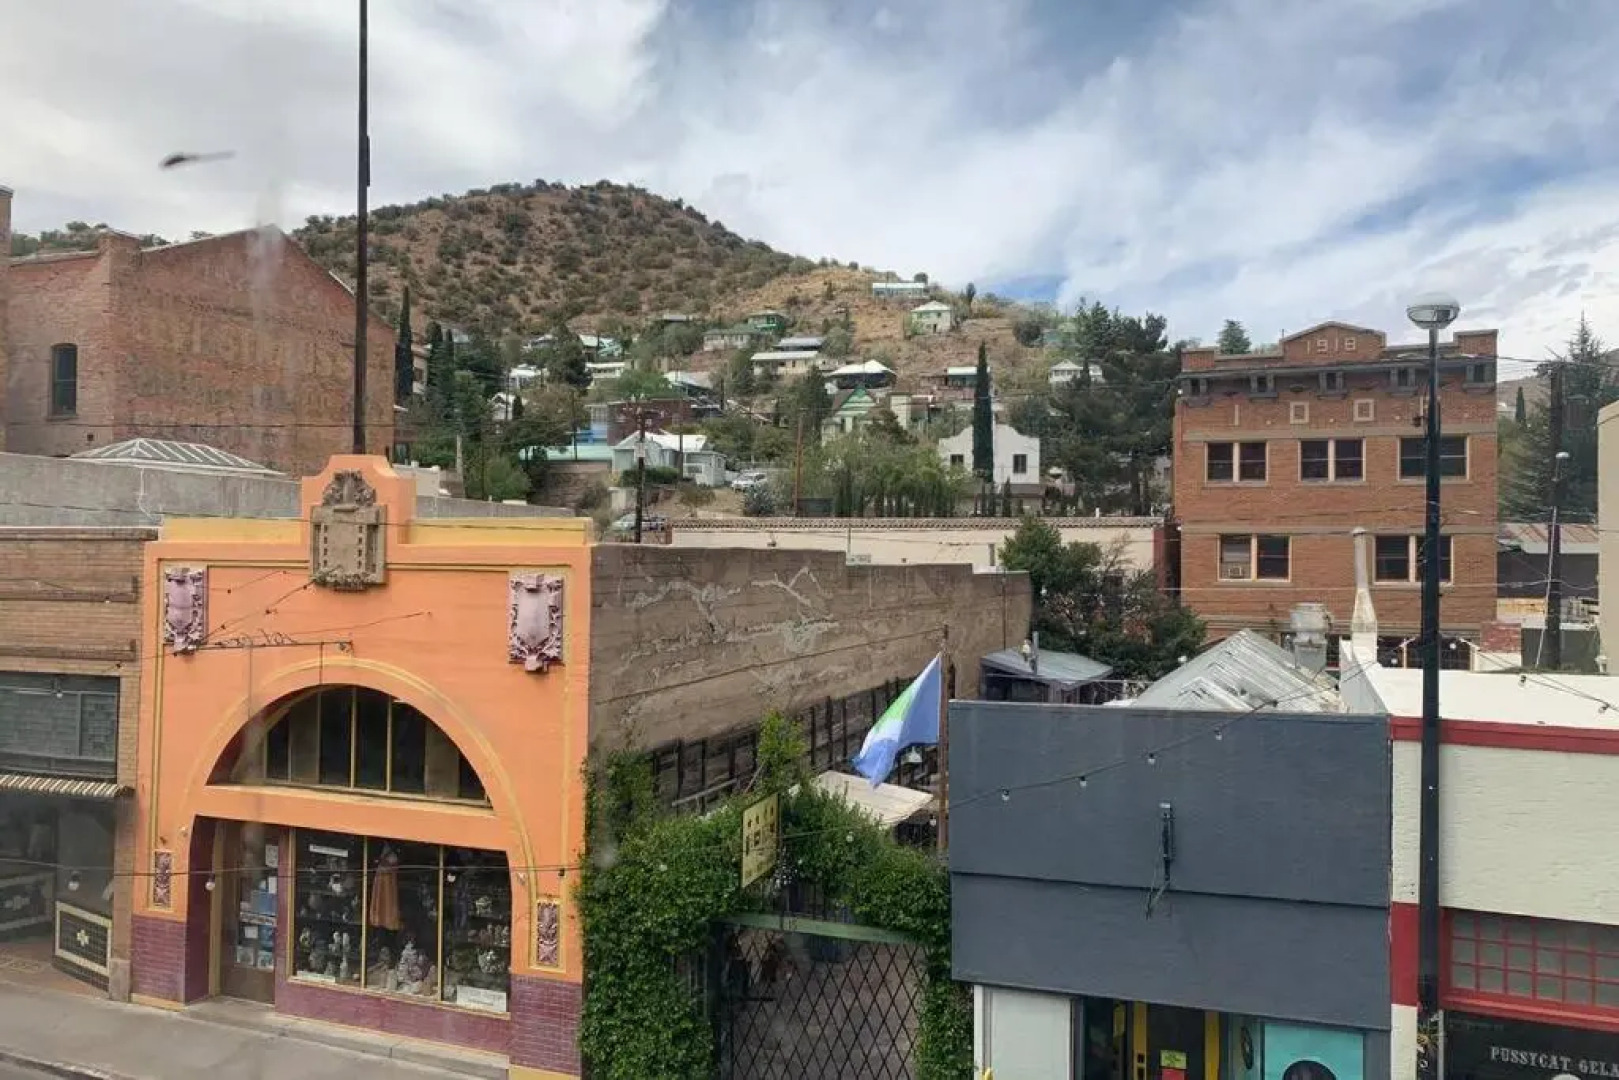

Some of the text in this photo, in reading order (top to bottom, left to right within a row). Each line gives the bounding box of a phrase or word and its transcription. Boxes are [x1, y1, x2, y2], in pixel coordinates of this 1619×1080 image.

[1306, 336, 1356, 354] 1918
[1491, 1047, 1619, 1078] PUSSYCAT GELA
